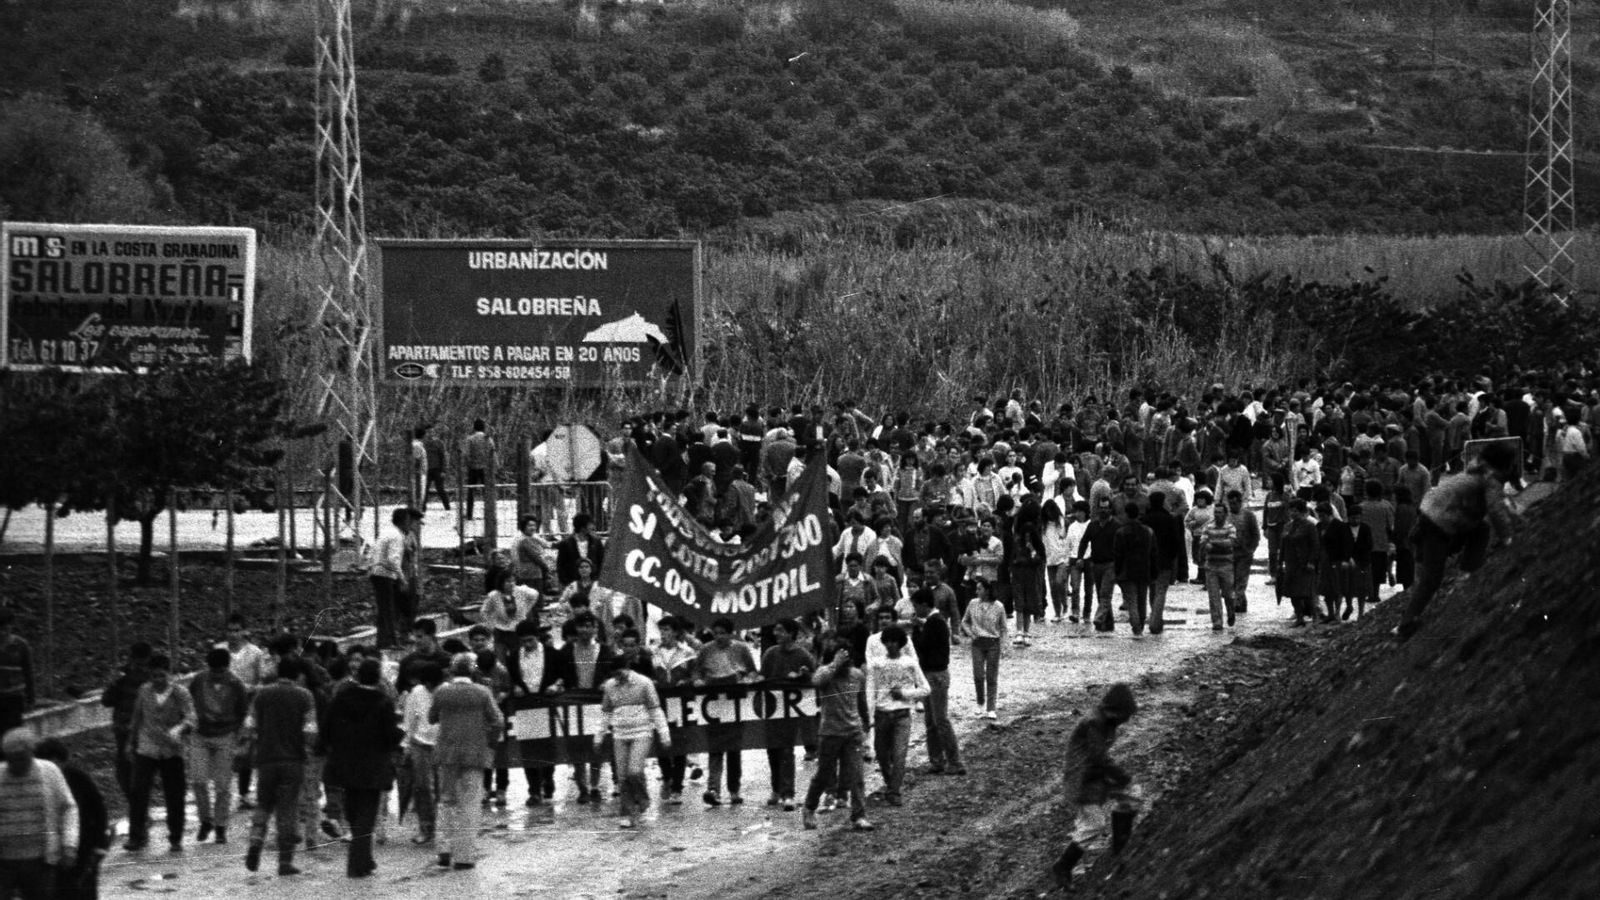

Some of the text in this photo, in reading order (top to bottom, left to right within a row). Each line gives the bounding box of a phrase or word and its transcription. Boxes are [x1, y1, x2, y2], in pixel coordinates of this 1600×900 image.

[71, 240, 240, 258] EN LA COSTA GRANADINA
[10, 258, 227, 297] SALOBREÑA
[476, 295, 602, 316] SALOBREÑA
[40, 339, 57, 361] 61
[61, 340, 77, 362] 10
[80, 340, 100, 362] 37
[388, 345, 490, 361] APARTAMENTOS
[493, 346, 504, 361] A
[507, 346, 550, 361] PAGAR
[555, 347, 574, 361] EN
[579, 347, 598, 362] 20
[628, 504, 657, 540] SI
[711, 563, 821, 614] MOTRIL
